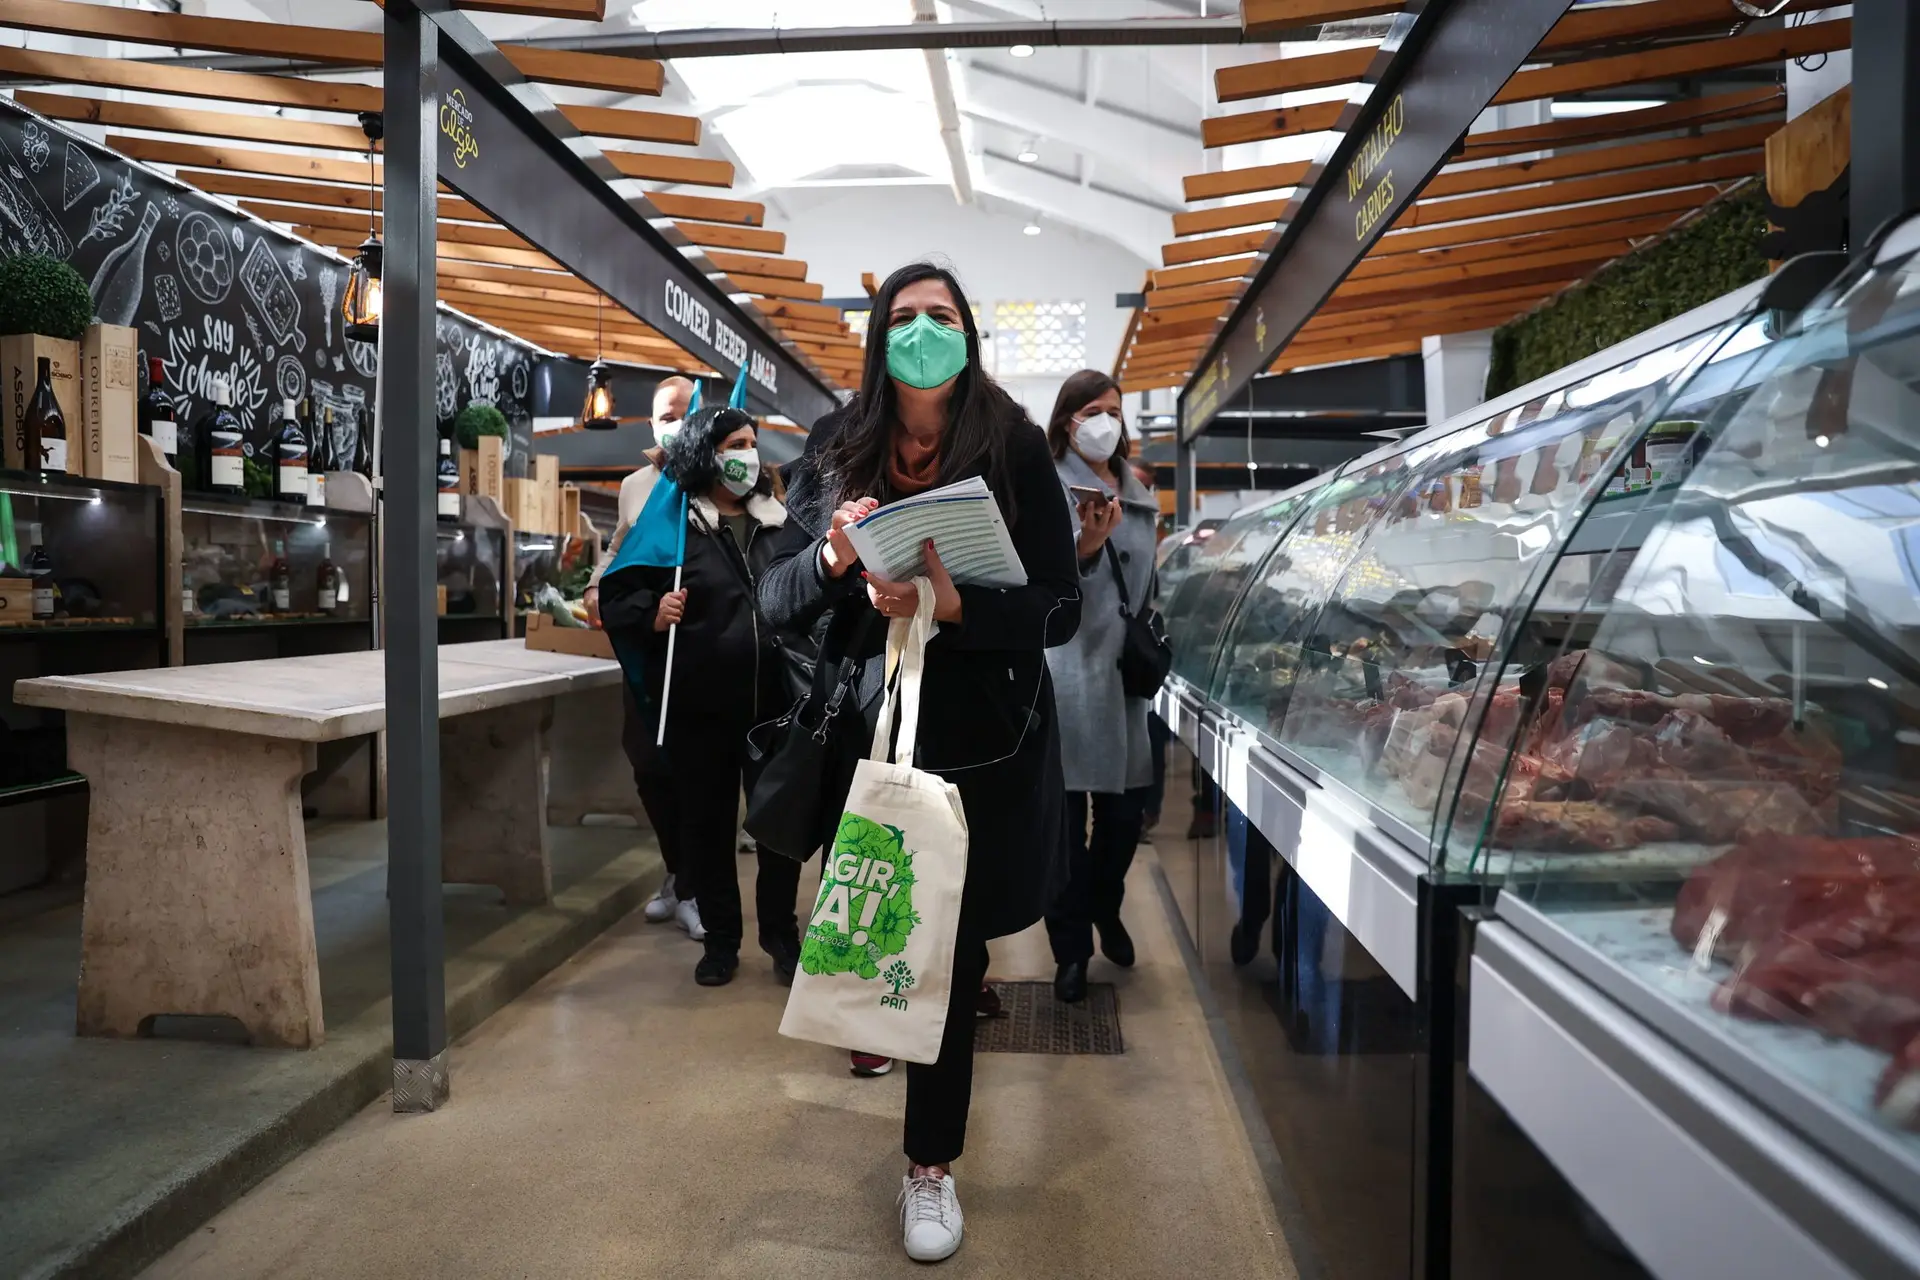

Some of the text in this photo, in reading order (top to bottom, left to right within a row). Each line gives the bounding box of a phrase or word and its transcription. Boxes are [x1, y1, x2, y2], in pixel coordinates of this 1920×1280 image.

[446, 93, 473, 123] MERCADO
[1355, 169, 1394, 241] CARNES
[203, 314, 234, 355] SAY
[14, 366, 25, 452] ASSOBIO
[90, 355, 101, 454] LOUREIRO
[880, 995, 908, 1011] PAN
